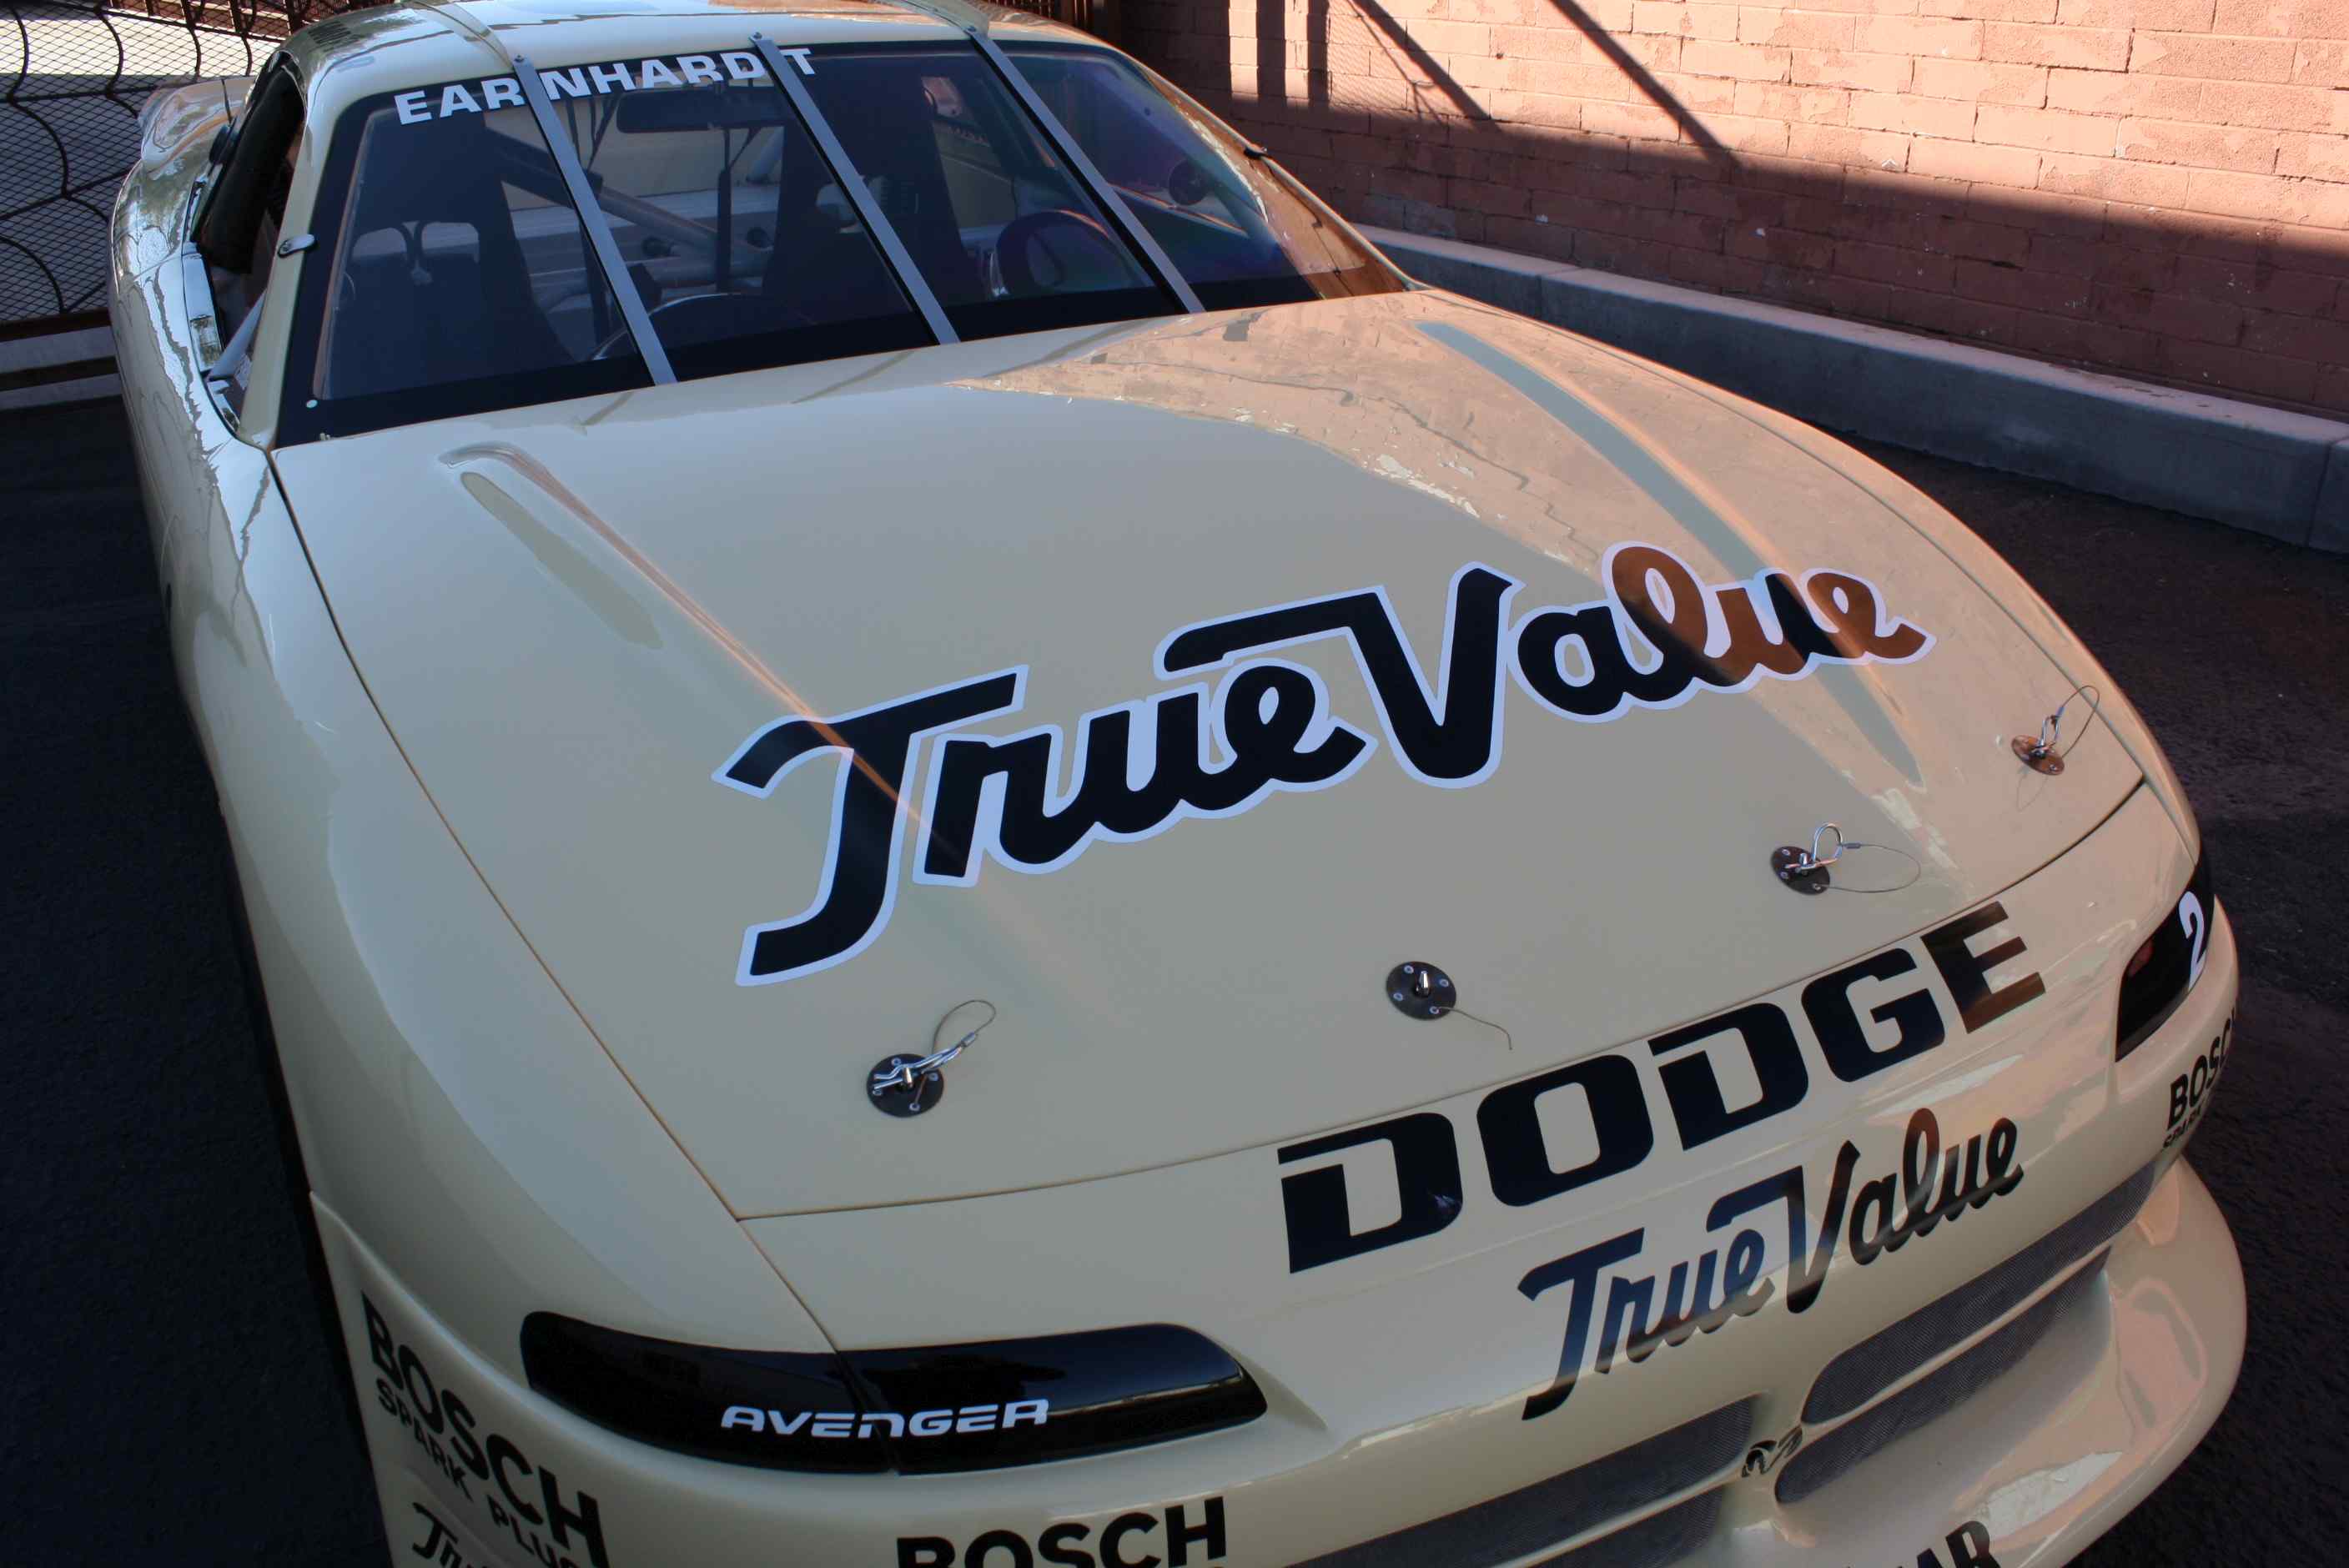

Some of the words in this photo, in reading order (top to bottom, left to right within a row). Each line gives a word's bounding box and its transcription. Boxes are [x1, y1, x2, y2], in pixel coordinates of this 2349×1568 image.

[394, 48, 816, 124] EARNHARDT
[714, 666, 1375, 983] True
[1156, 540, 1934, 786] Value
[1277, 901, 2046, 1274] DODGE
[2167, 1008, 2236, 1130] BOSC
[1517, 1227, 1776, 1420] True
[1707, 1108, 2025, 1314] Value
[361, 1290, 611, 1568] BOSCH
[376, 1378, 473, 1501] SPARK
[721, 1399, 1049, 1438] AVENGER
